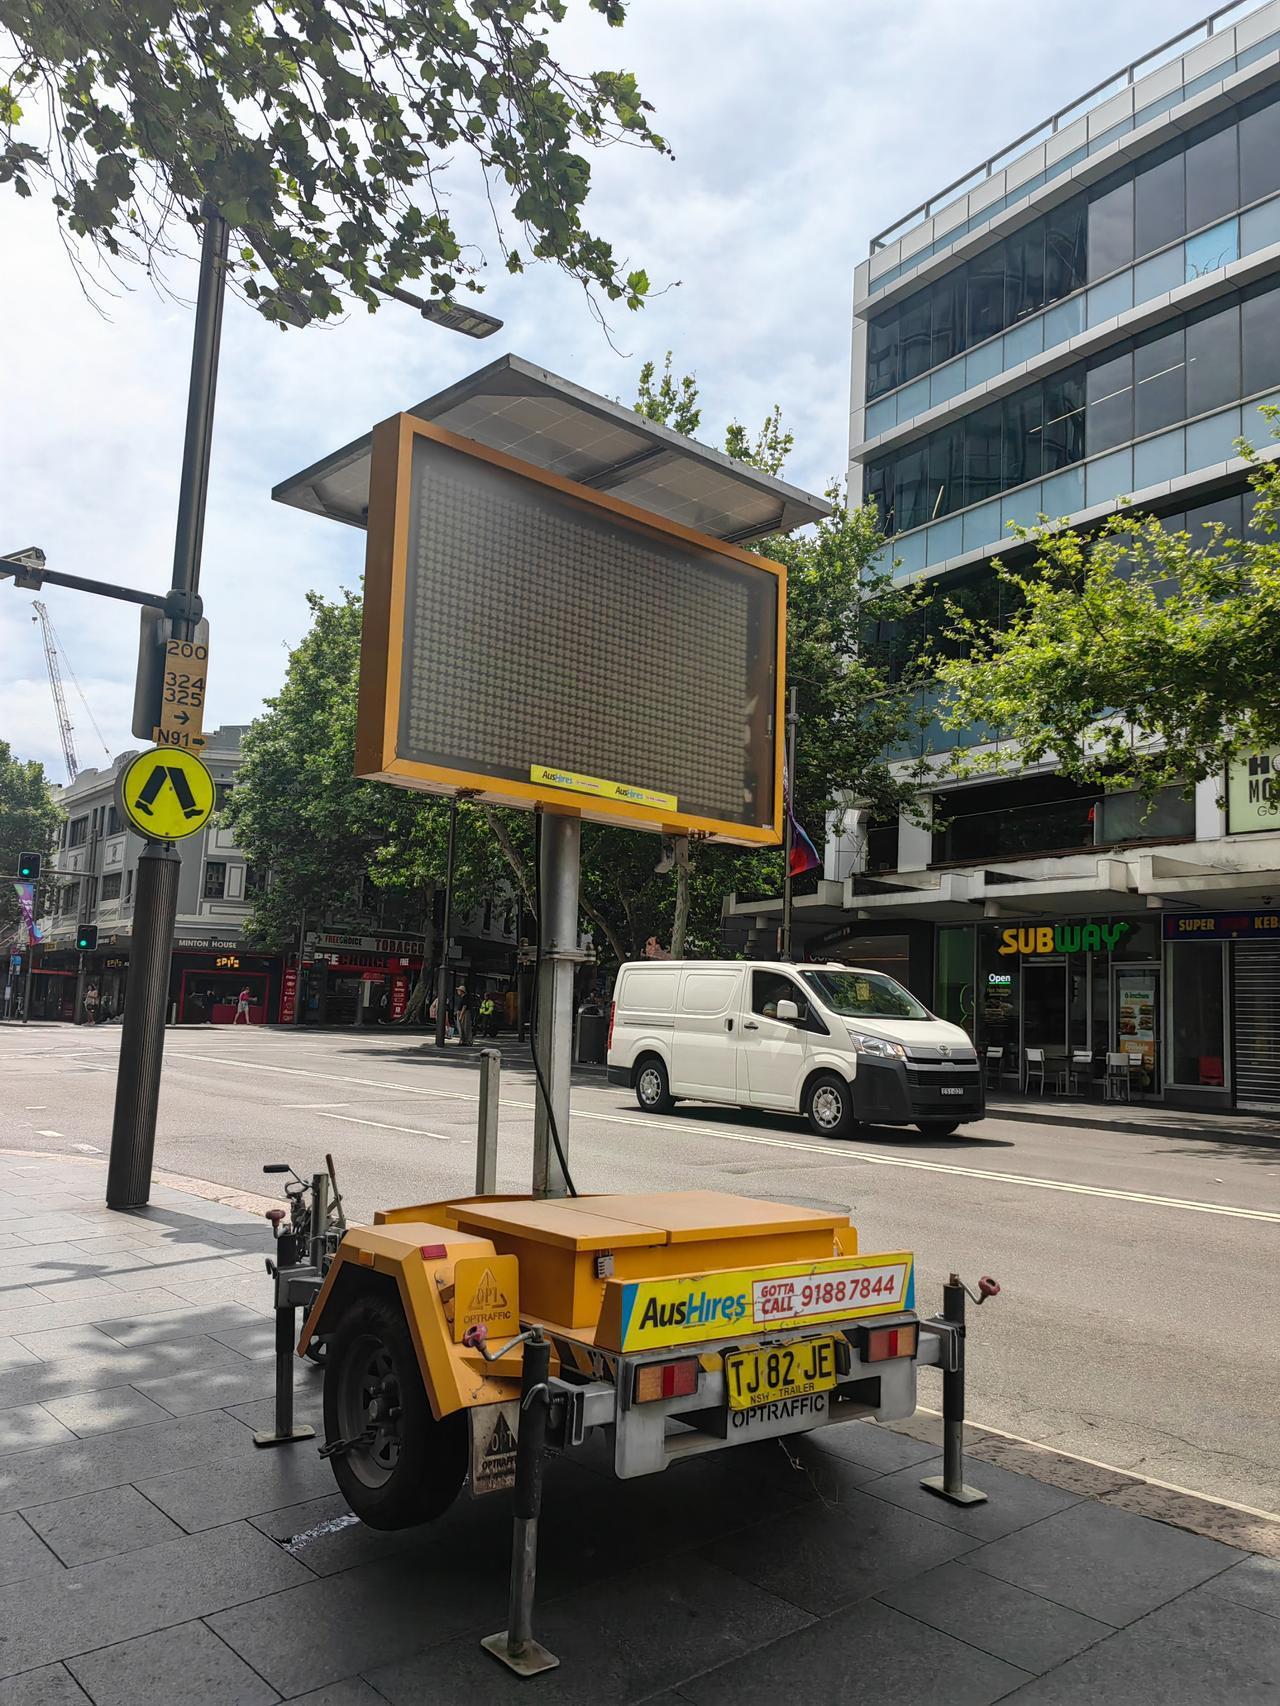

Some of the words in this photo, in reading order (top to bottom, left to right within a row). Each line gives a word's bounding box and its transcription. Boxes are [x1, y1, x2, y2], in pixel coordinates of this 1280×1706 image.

[167, 640, 207, 660] 200
[165, 672, 204, 692] 324
[164, 687, 202, 707] 325
[158, 729, 190, 747] N91
[542, 770, 574, 785] AusHires
[615, 786, 645, 800] AusHires
[1178, 919, 1215, 931] SUPER
[1254, 916, 1280, 928] KEB
[212, 941, 238, 949] HOUSE
[375, 939, 424, 954] TOBACCO
[998, 922, 1131, 957] SUBWAY
[988, 973, 1011, 984] Open
[761, 1283, 795, 1298] GOTTA
[801, 1275, 895, 1307] 91887844
[639, 1291, 747, 1330] AusHires
[761, 1296, 794, 1315] CALL
[463, 1311, 512, 1324] OPTRAFFIC
[750, 1391, 770, 1404] NSW
[779, 1382, 815, 1397] TRAILER
[732, 1394, 825, 1428] OPTRAFFIC
